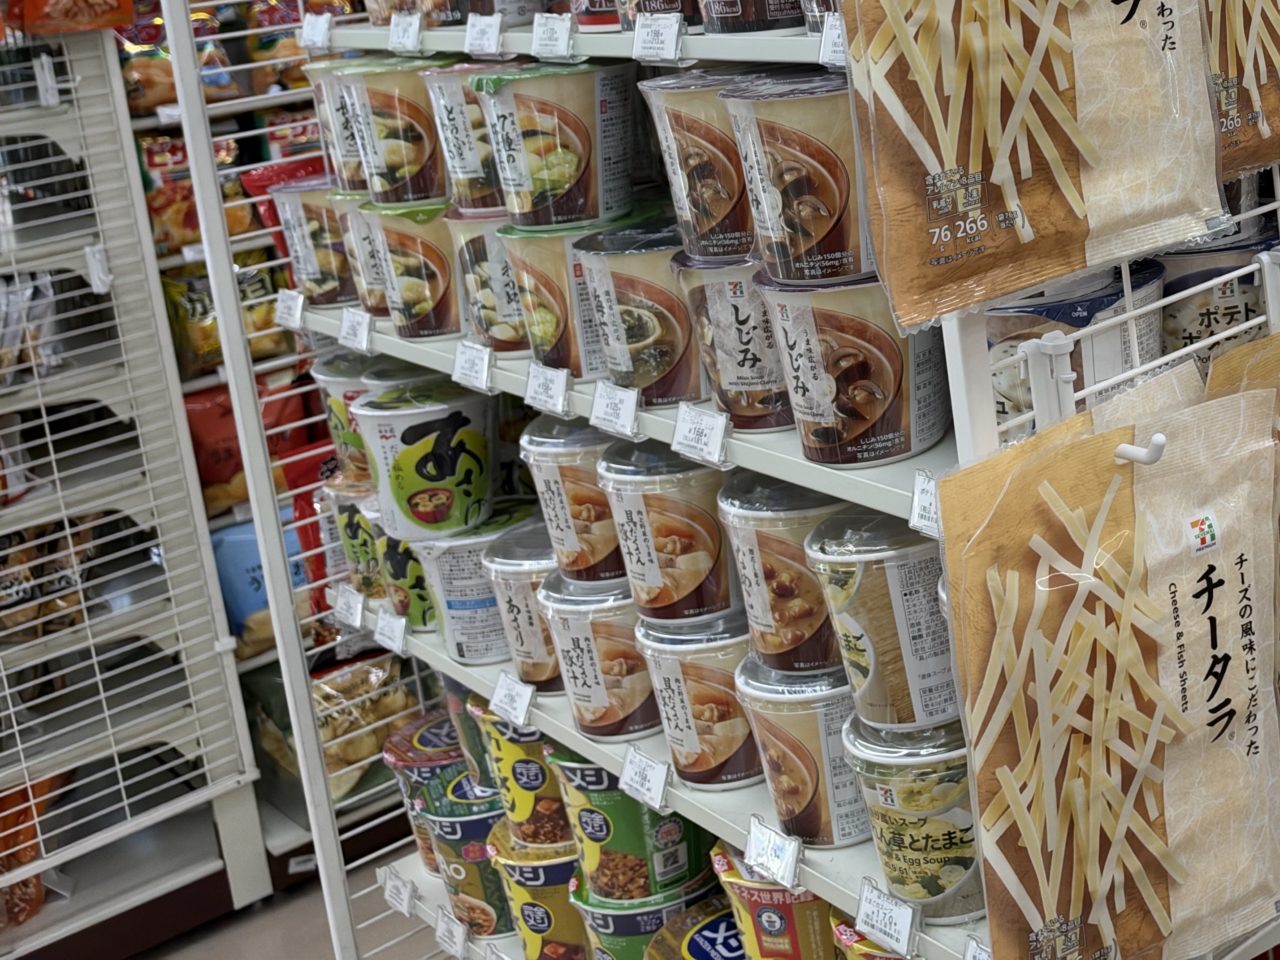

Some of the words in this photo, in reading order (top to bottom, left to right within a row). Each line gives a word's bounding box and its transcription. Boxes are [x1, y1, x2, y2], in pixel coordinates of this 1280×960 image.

[1219, 114, 1242, 132] 266
[929, 224, 952, 245] 76
[954, 214, 988, 238] 266
[1071, 310, 1088, 318] OPEN
[1198, 304, 1259, 329] ポテト
[731, 304, 763, 369] しじみ
[781, 326, 809, 398] しじみ
[1168, 582, 1181, 628] Cheese
[1176, 644, 1185, 668] Fish
[1192, 563, 1237, 744] チータラ
[1234, 553, 1260, 757] チーズの風味にこだわった
[1179, 672, 1189, 714] Sheets
[902, 855, 921, 867] Egg
[923, 856, 950, 866] Soup
